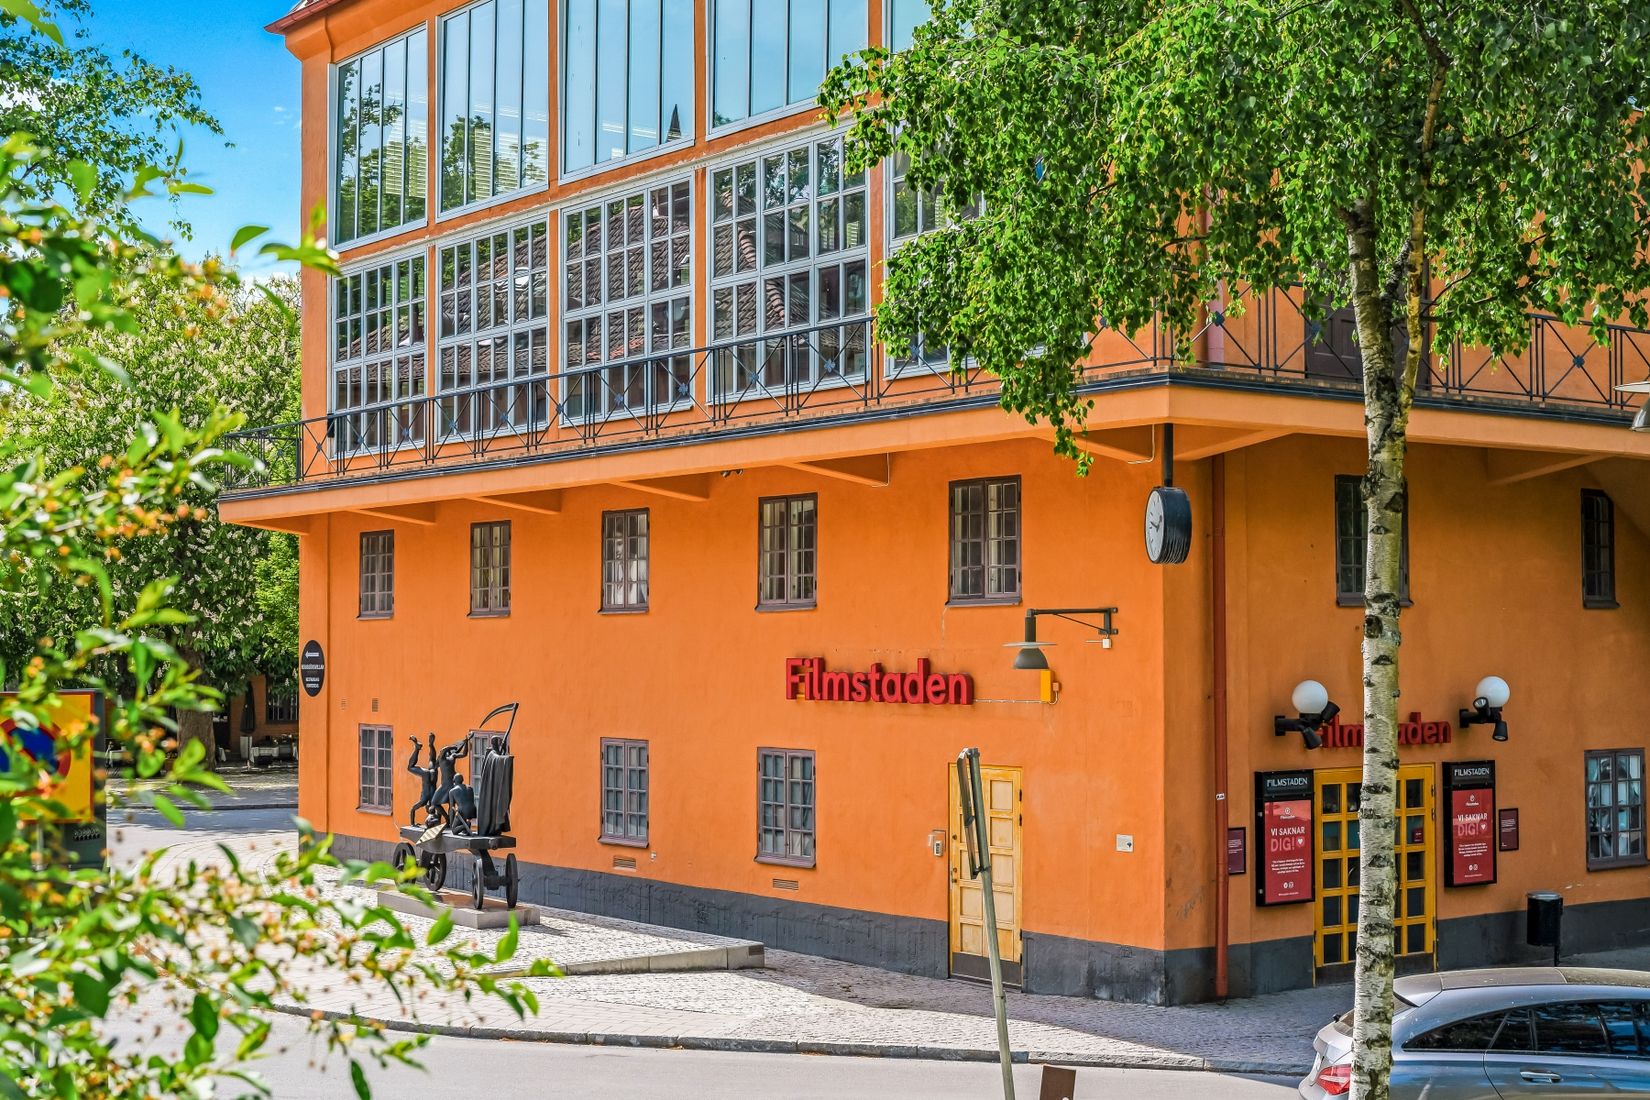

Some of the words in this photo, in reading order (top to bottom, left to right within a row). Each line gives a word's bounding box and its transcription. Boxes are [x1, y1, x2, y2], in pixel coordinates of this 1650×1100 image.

[786, 657, 974, 705] Filmstaden
[1454, 767, 1490, 777] FILMSTADEN
[1266, 777, 1308, 787] FILMSTADEN
[1457, 814, 1464, 822] VI
[1465, 812, 1488, 821] SAKNAR
[1270, 828, 1278, 836] VI
[1278, 826, 1305, 836] SAKNAR
[1457, 822, 1479, 836] DIG!
[1270, 837, 1295, 852] DIG!
